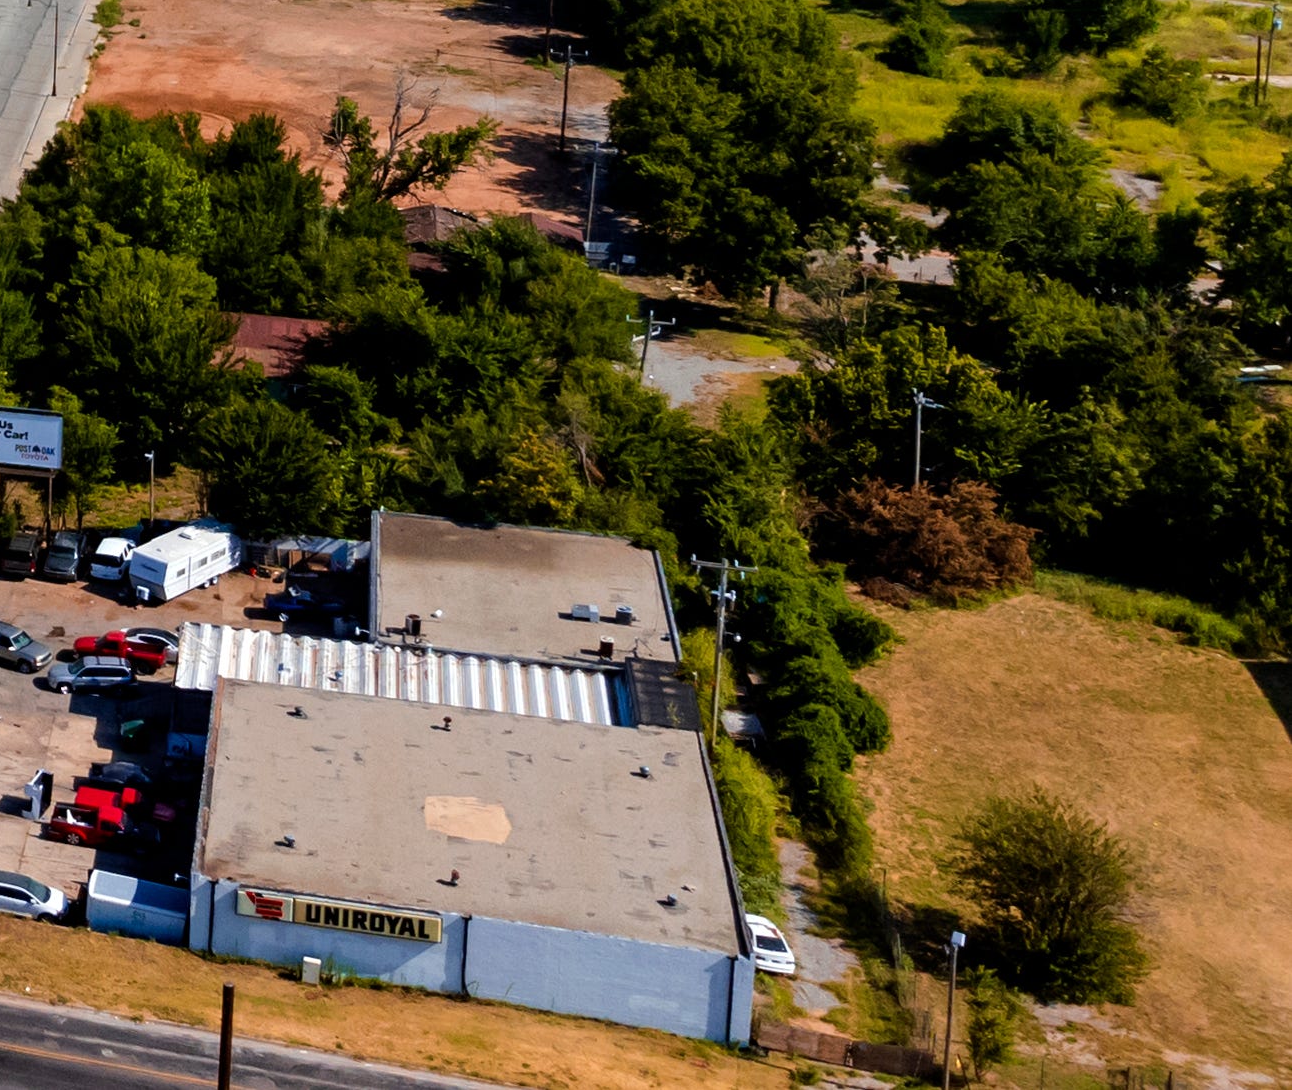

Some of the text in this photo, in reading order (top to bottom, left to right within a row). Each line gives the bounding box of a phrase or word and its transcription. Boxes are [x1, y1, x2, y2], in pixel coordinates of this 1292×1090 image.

[4, 430, 28, 440] Car!
[42, 446, 55, 456] OAK
[21, 453, 49, 461] TOYOTA
[305, 903, 430, 939] UNIROYAL
